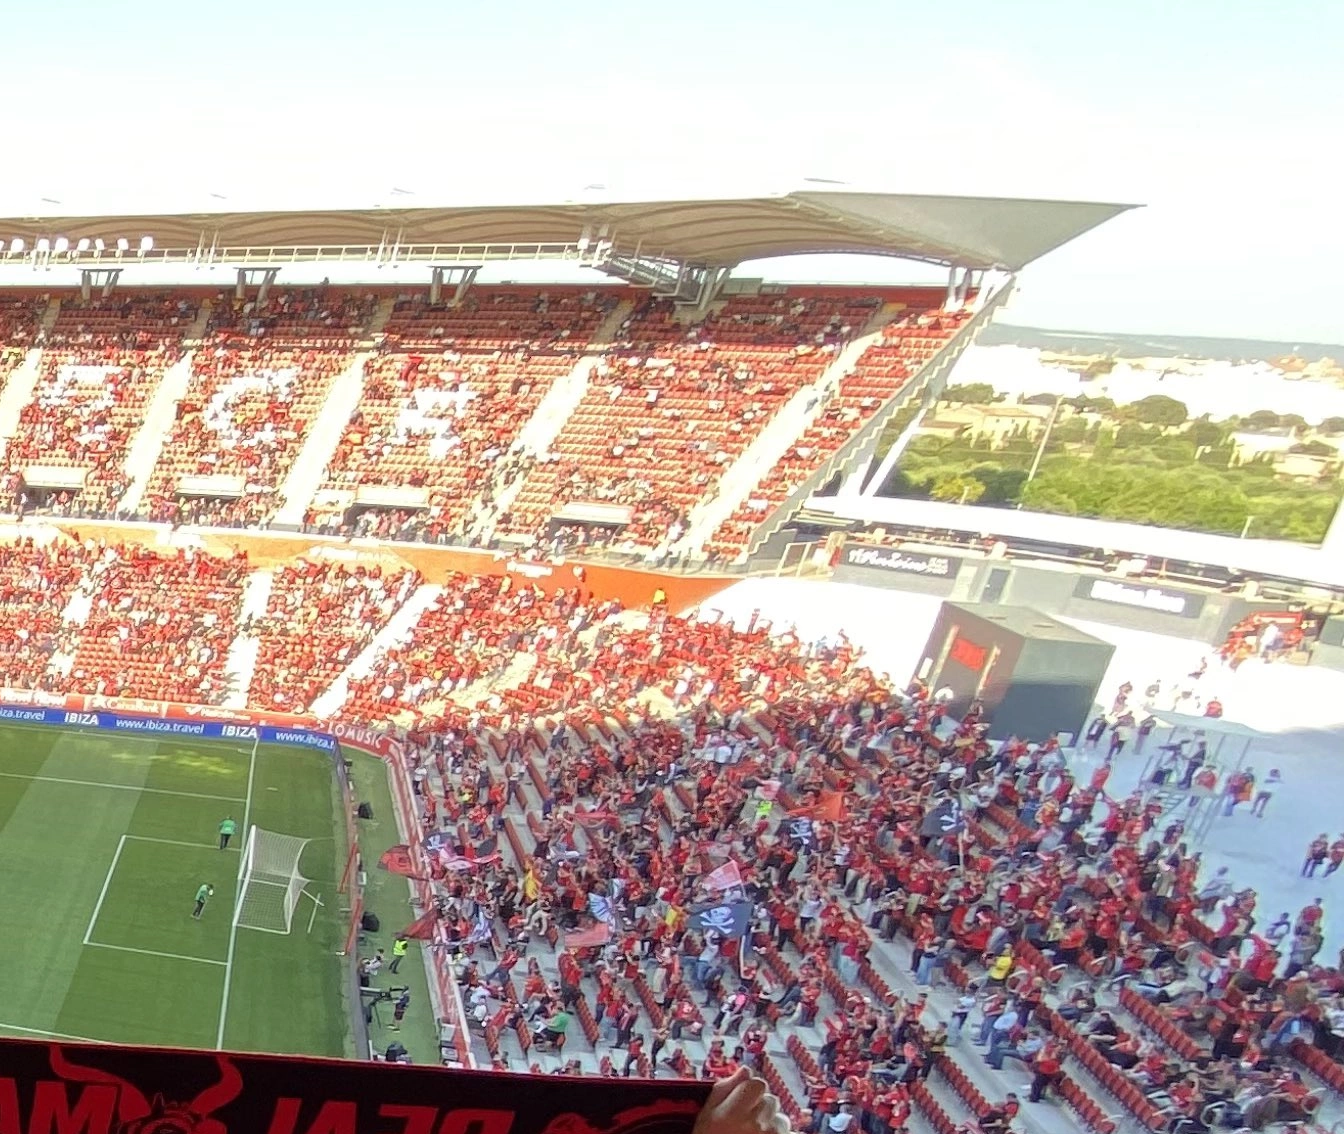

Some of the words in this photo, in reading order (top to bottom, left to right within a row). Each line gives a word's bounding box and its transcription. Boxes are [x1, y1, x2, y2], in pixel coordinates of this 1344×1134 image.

[63, 712, 100, 726] IBIZA
[116, 717, 205, 735] www.ibiza.travel
[221, 724, 258, 739] IBIZA
